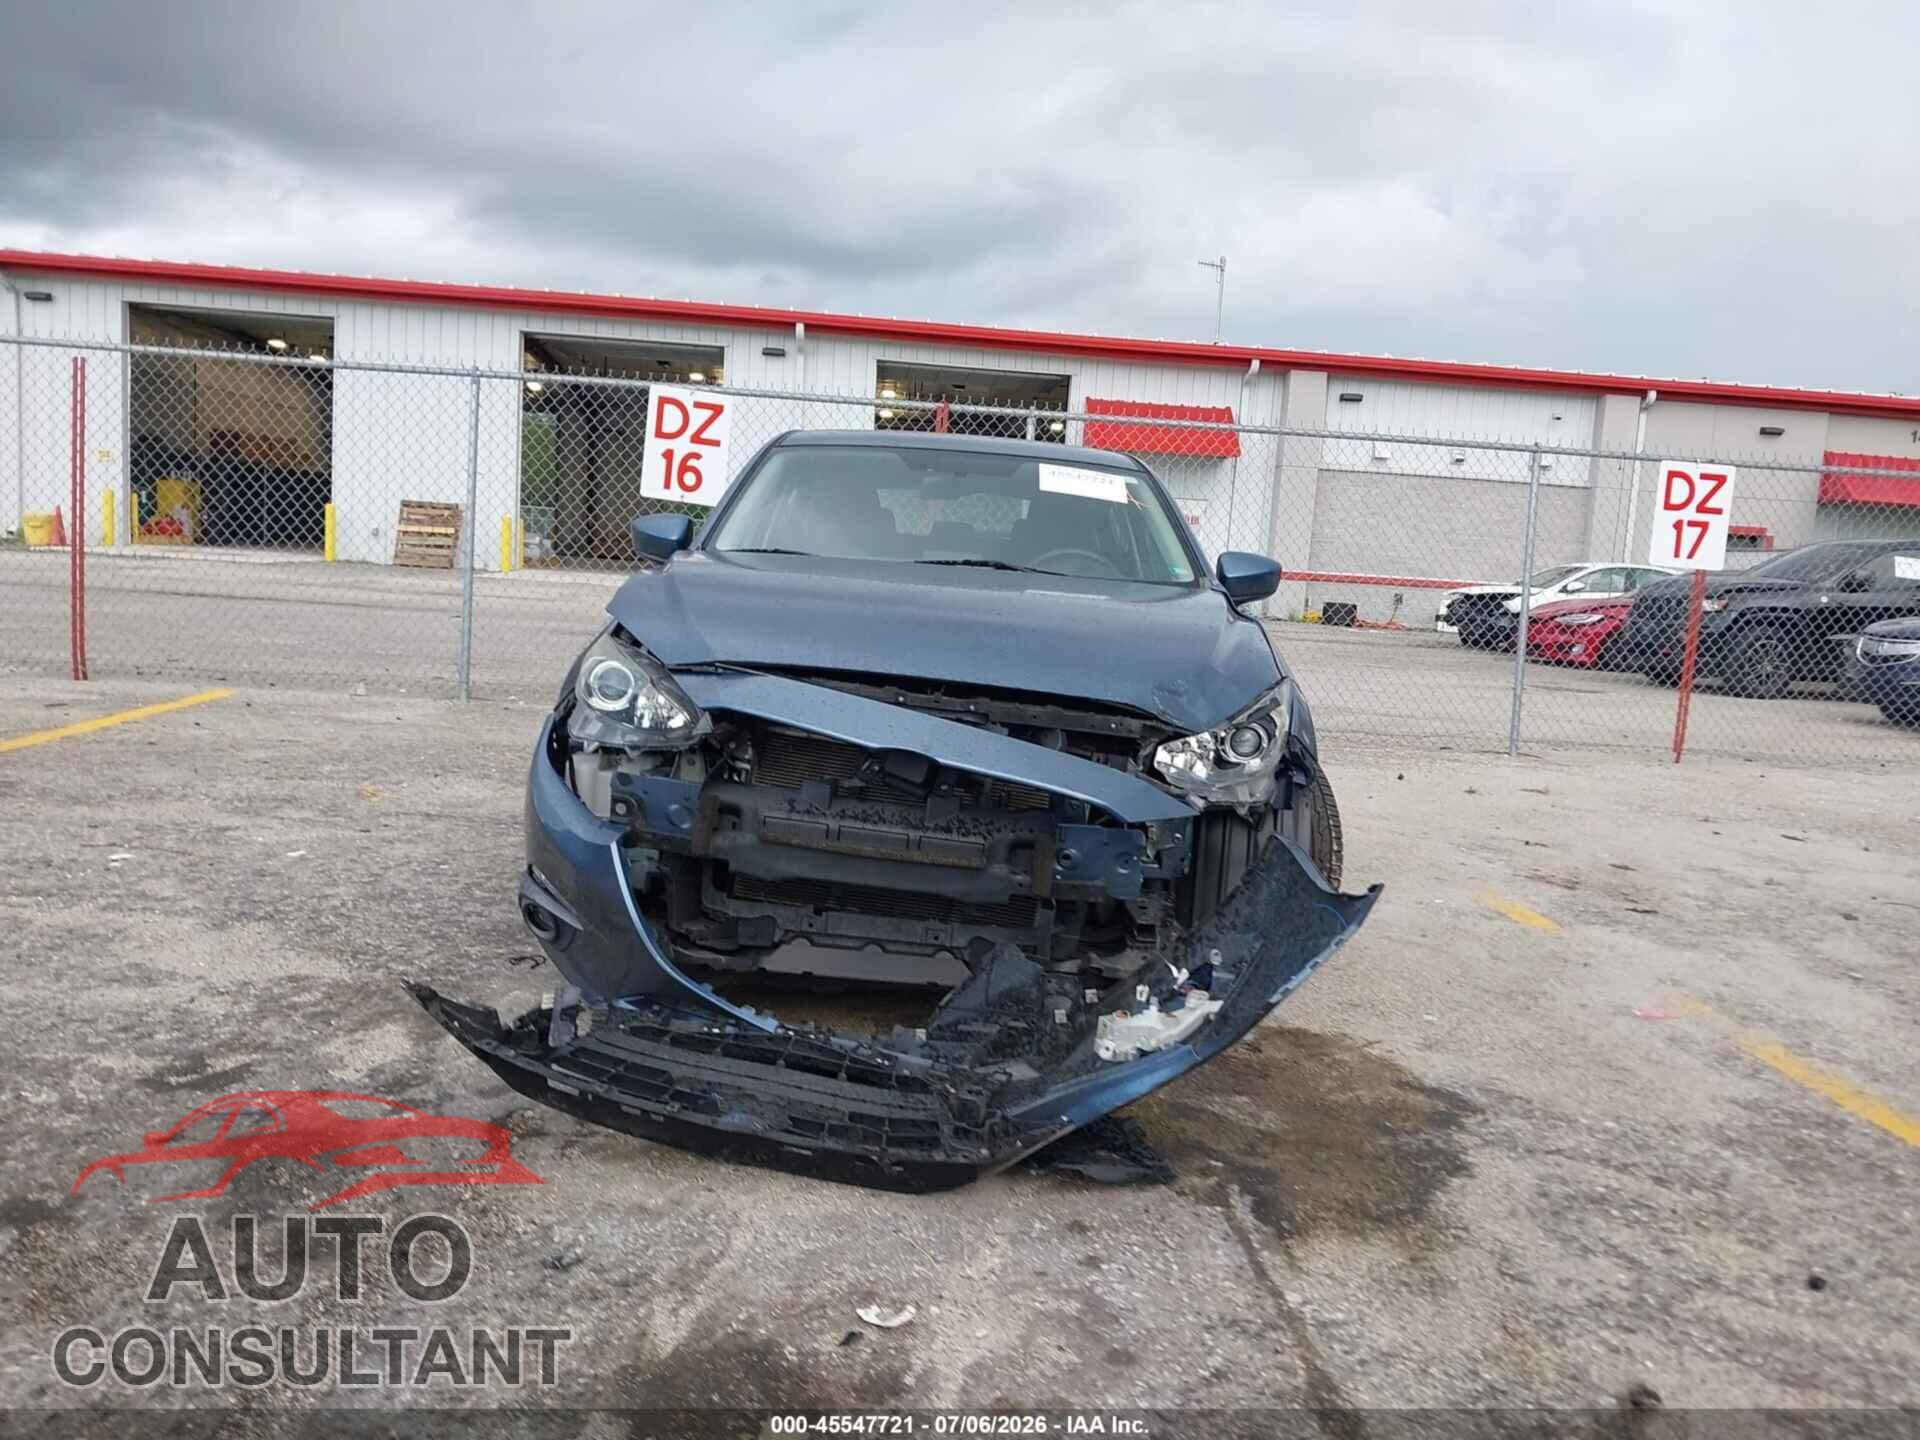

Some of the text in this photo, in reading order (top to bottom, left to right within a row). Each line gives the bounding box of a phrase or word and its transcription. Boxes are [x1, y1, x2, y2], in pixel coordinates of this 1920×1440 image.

[655, 395, 725, 447] DZ
[661, 448, 703, 493] 16
[1663, 470, 1728, 515] DZ
[1672, 519, 1710, 560] 17
